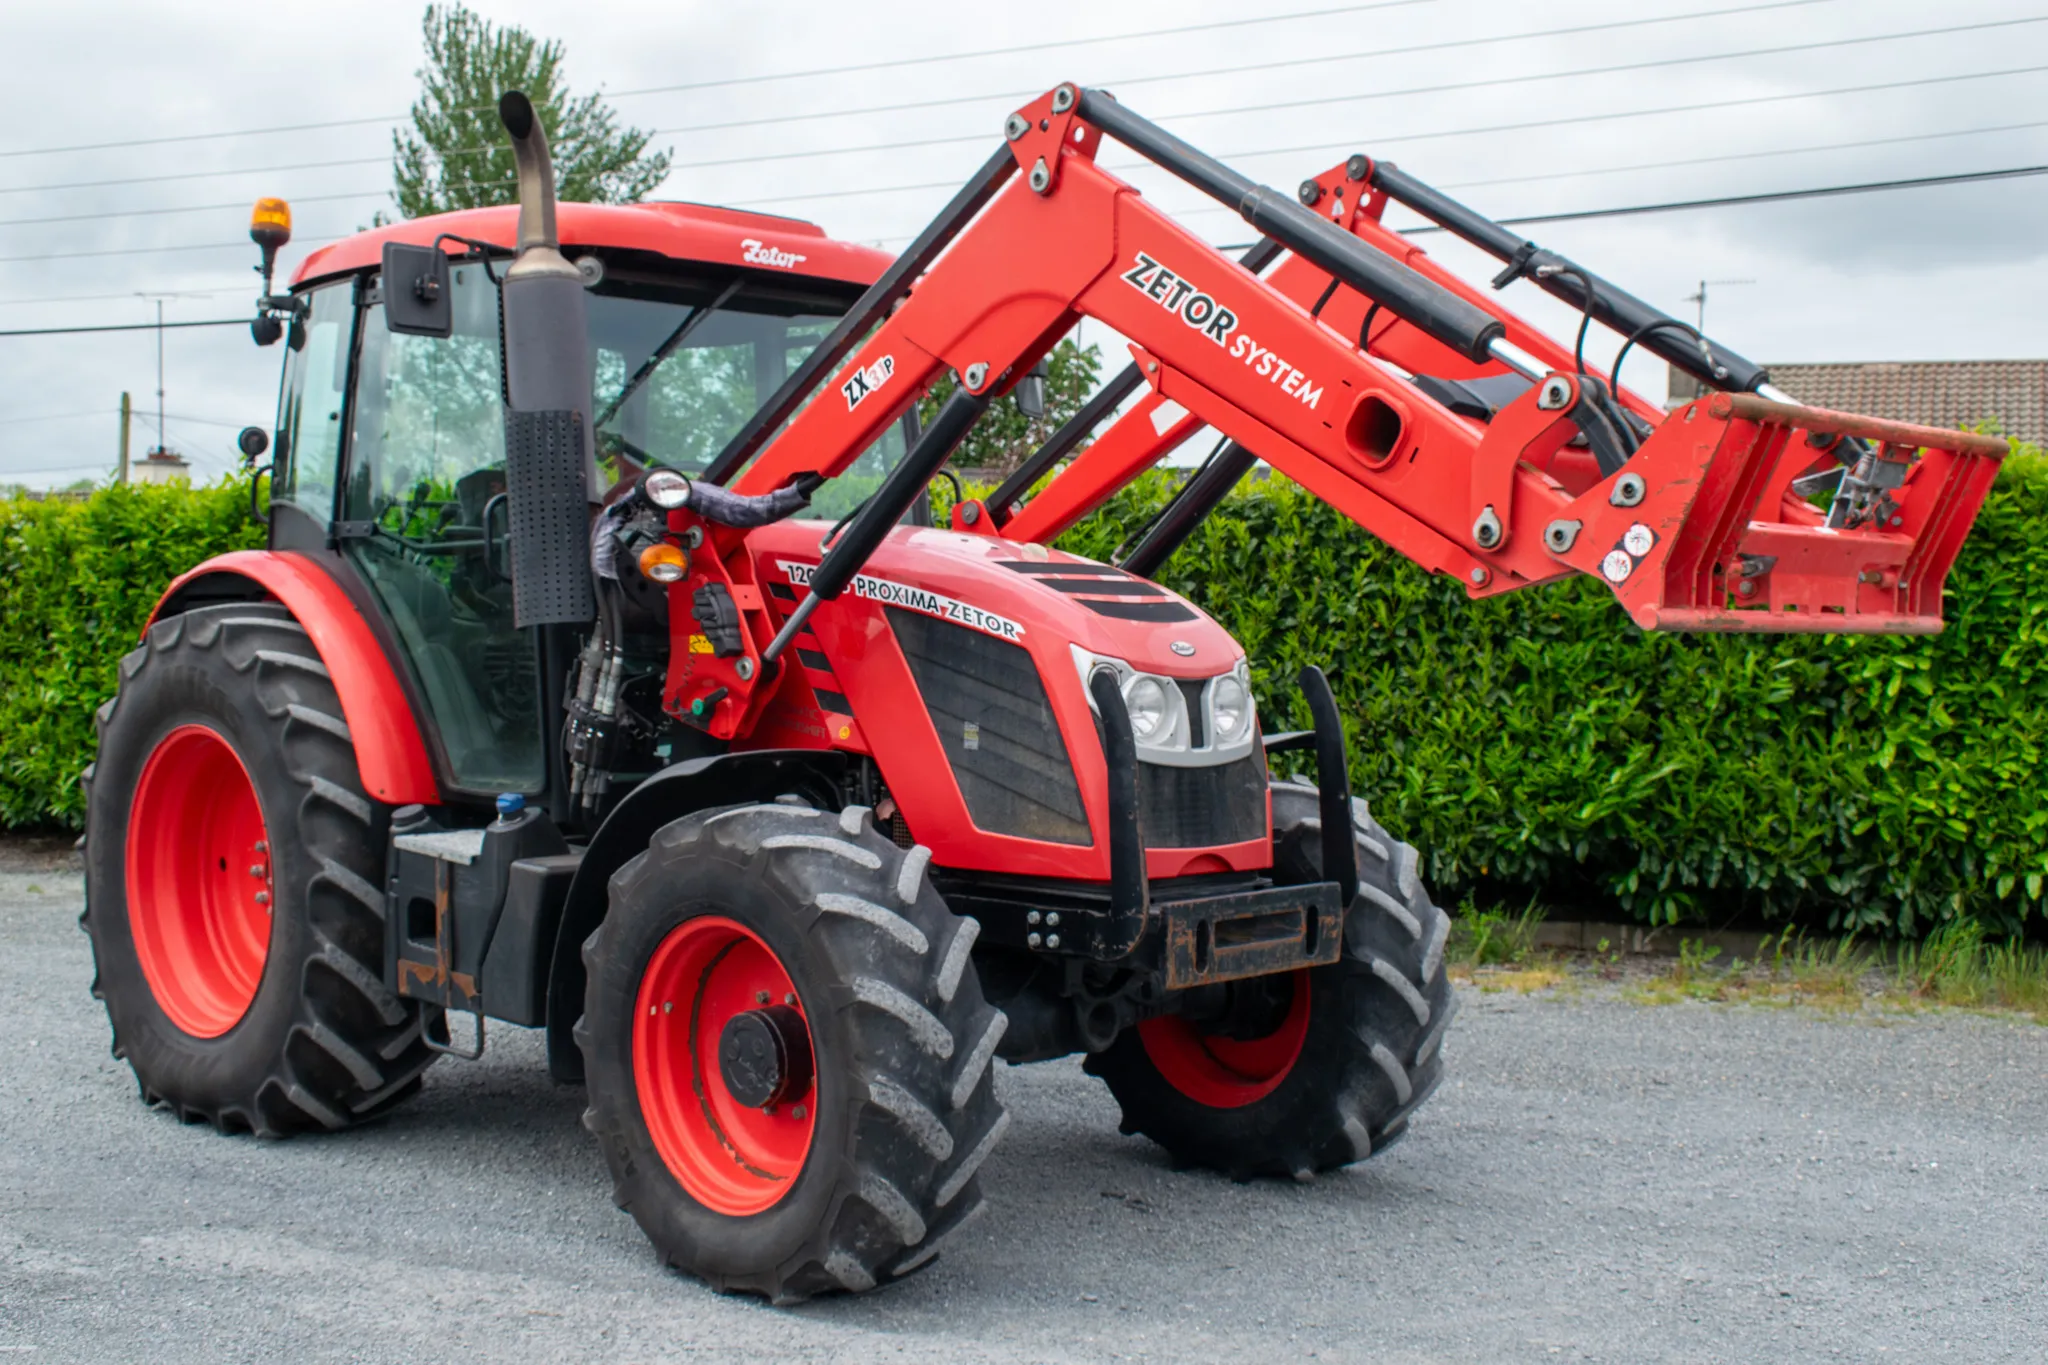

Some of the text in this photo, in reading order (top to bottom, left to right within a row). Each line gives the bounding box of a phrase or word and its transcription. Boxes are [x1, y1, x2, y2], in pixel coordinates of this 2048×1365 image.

[741, 238, 807, 268] Zetor
[1120, 251, 1324, 410] ZETOR SYSTEM
[856, 577, 940, 613] PROXIMA
[948, 601, 1017, 639] ZETOR
